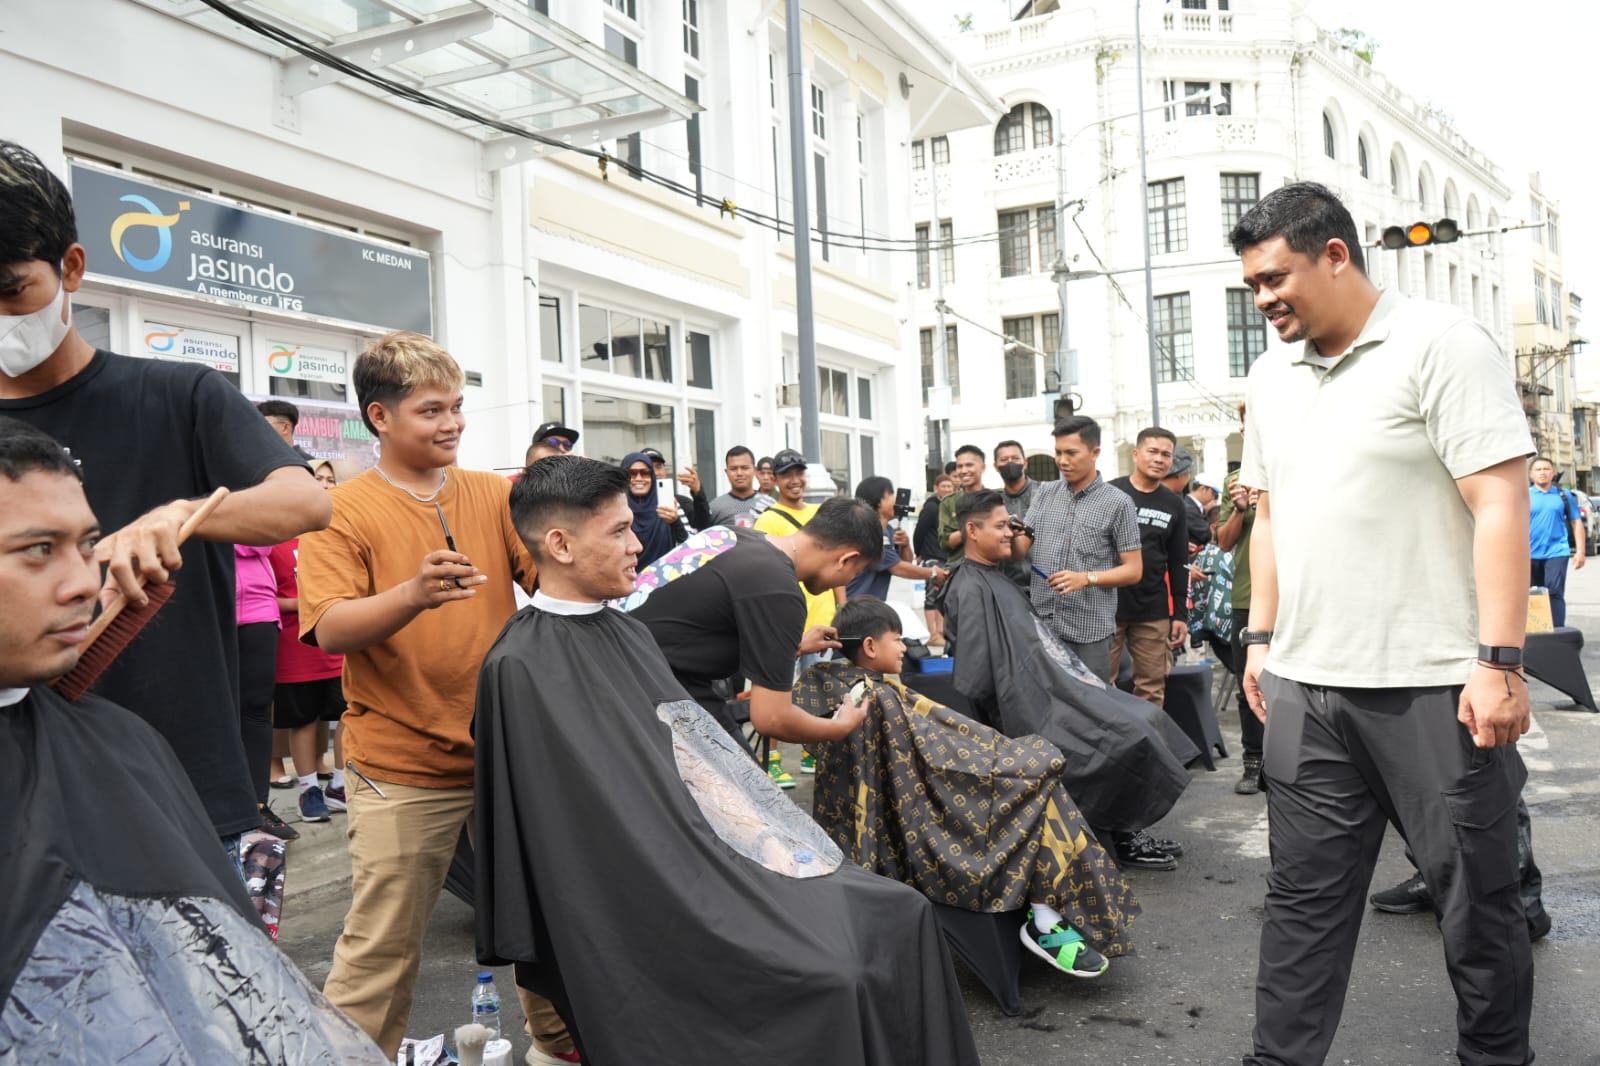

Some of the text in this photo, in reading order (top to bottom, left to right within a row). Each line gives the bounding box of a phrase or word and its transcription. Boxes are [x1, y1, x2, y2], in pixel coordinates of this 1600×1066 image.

[190, 230, 263, 259] asuransi
[362, 248, 412, 271] KC MEDAN
[187, 253, 295, 293] jasindo
[197, 282, 208, 294] A
[209, 286, 258, 304] member
[260, 295, 273, 306] of
[184, 337, 222, 348] asuransi
[182, 345, 237, 360] jasindo
[298, 360, 345, 375] jasindo
[1164, 411, 1222, 425] LONDON
